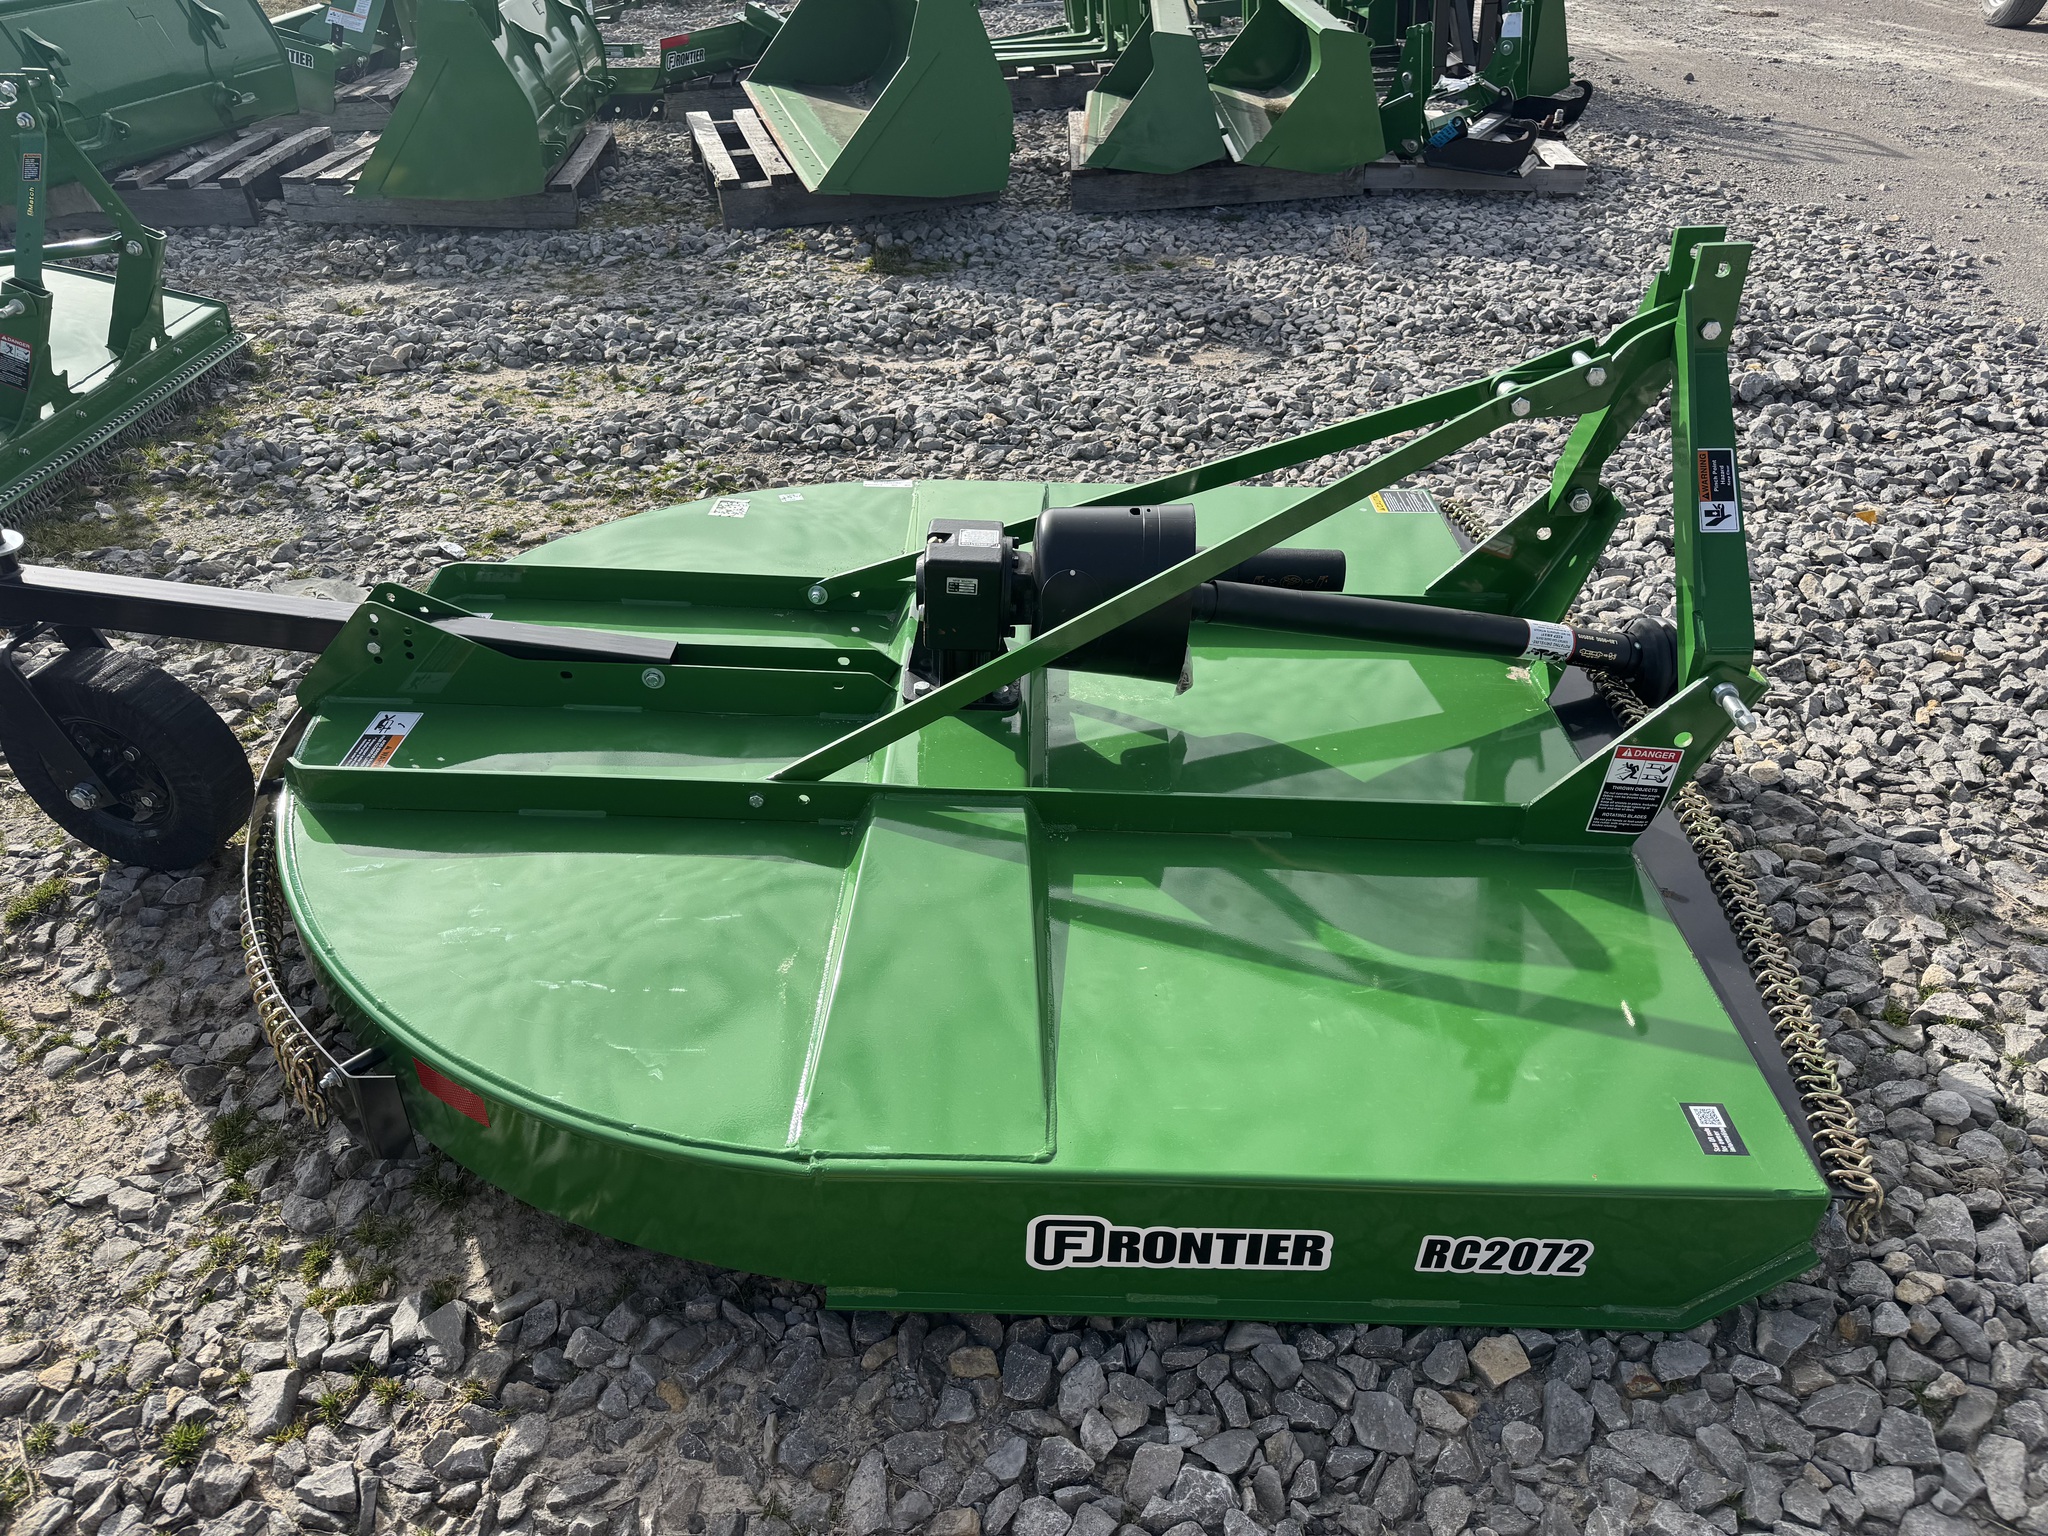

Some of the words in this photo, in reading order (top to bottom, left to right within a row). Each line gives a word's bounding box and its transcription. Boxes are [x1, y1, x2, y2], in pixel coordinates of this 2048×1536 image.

[287, 49, 313, 68] TIER
[667, 48, 704, 70] FRONTIER
[7, 337, 30, 349] DANGER
[1699, 453, 1709, 492] WARNING
[1633, 749, 1676, 760] DANGER
[1033, 1218, 1326, 1267] FRONTIER
[1419, 1238, 1590, 1273] RC2072
